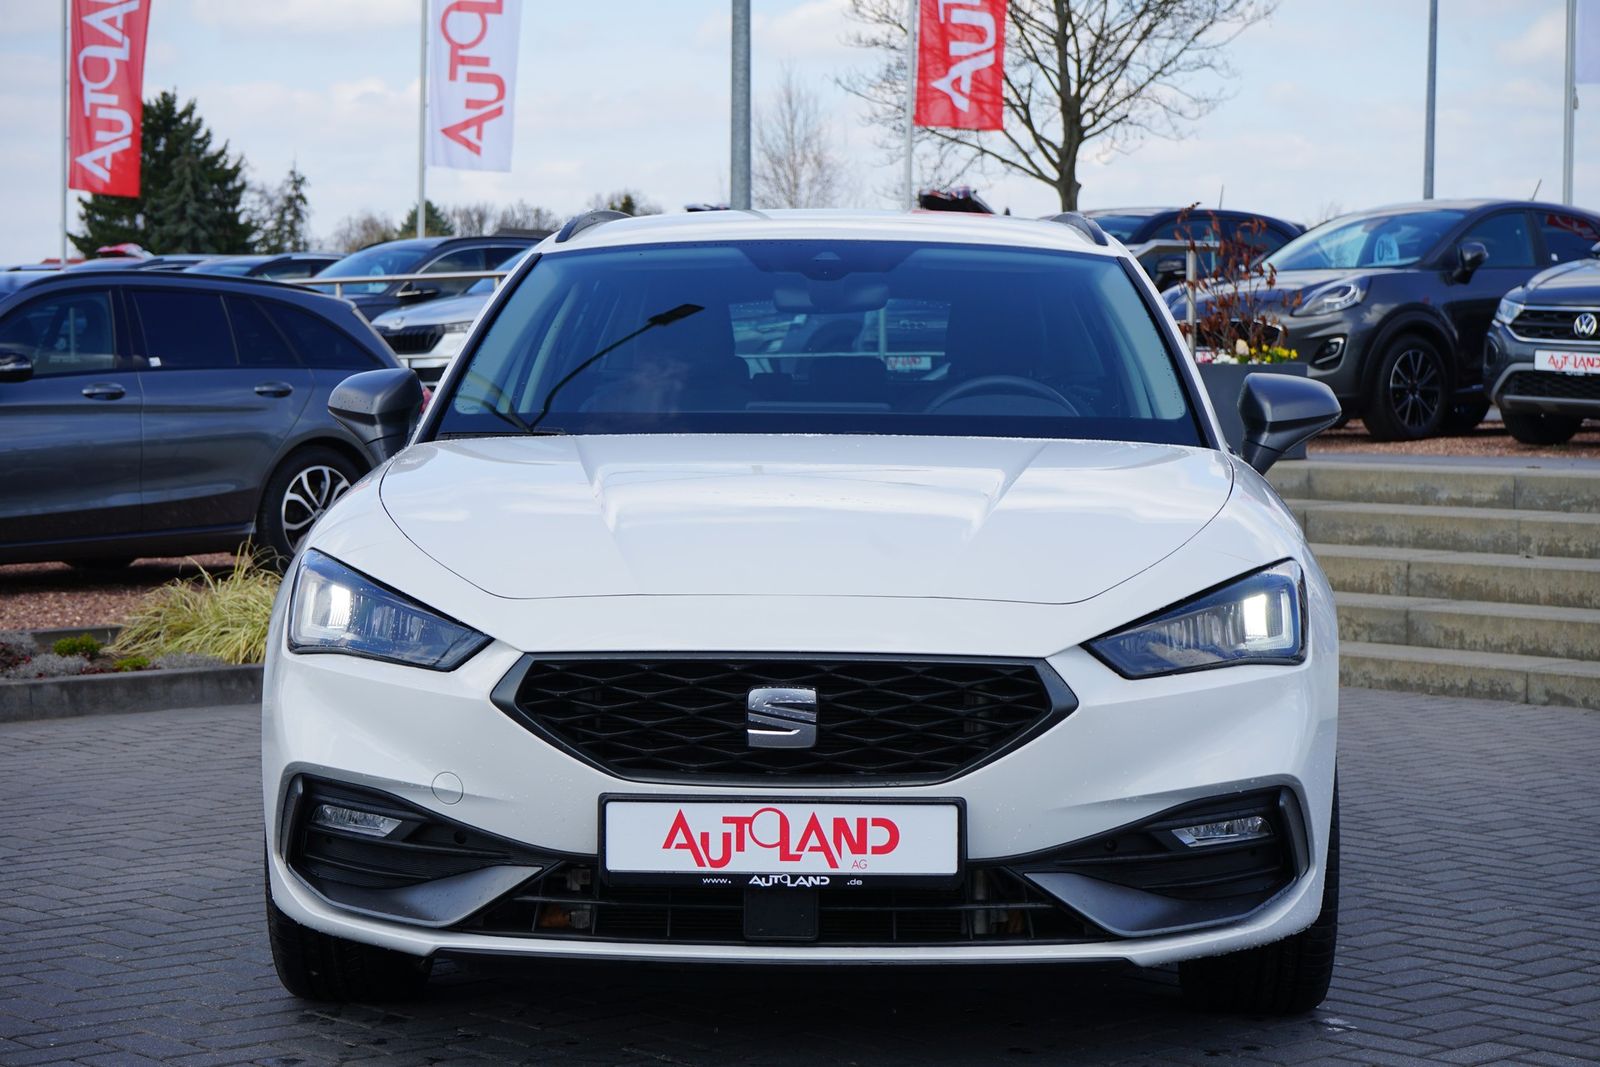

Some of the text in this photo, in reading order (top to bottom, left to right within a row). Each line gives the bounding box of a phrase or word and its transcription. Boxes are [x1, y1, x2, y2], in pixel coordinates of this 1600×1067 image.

[662, 807, 900, 869] AUTOLAND
[851, 859, 868, 869] AG
[749, 874, 830, 887] AUTOLAND
